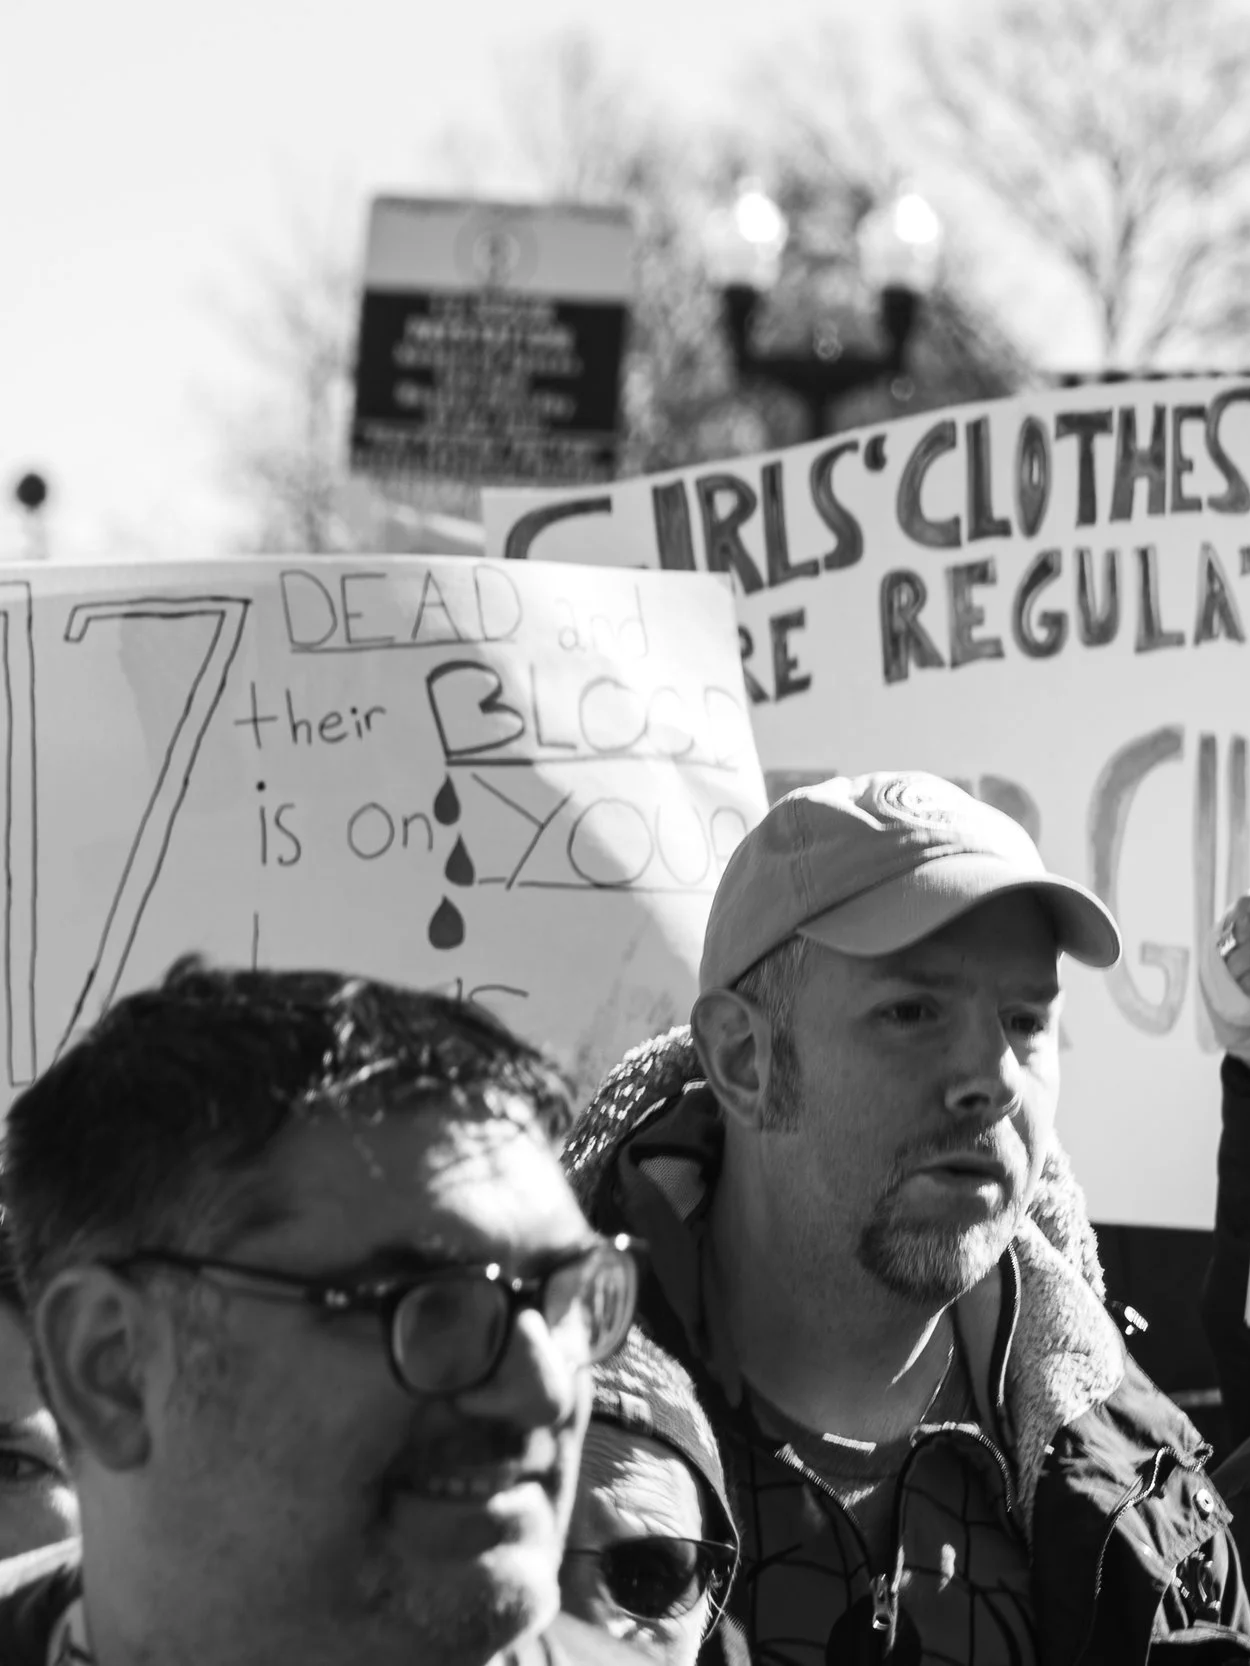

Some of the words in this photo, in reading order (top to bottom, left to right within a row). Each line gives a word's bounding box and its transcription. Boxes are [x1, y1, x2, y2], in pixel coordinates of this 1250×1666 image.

[279, 565, 522, 648] DEAD
[556, 582, 650, 659] and
[233, 681, 388, 751] their
[0, 576, 252, 1088] 17
[255, 779, 303, 868] is
